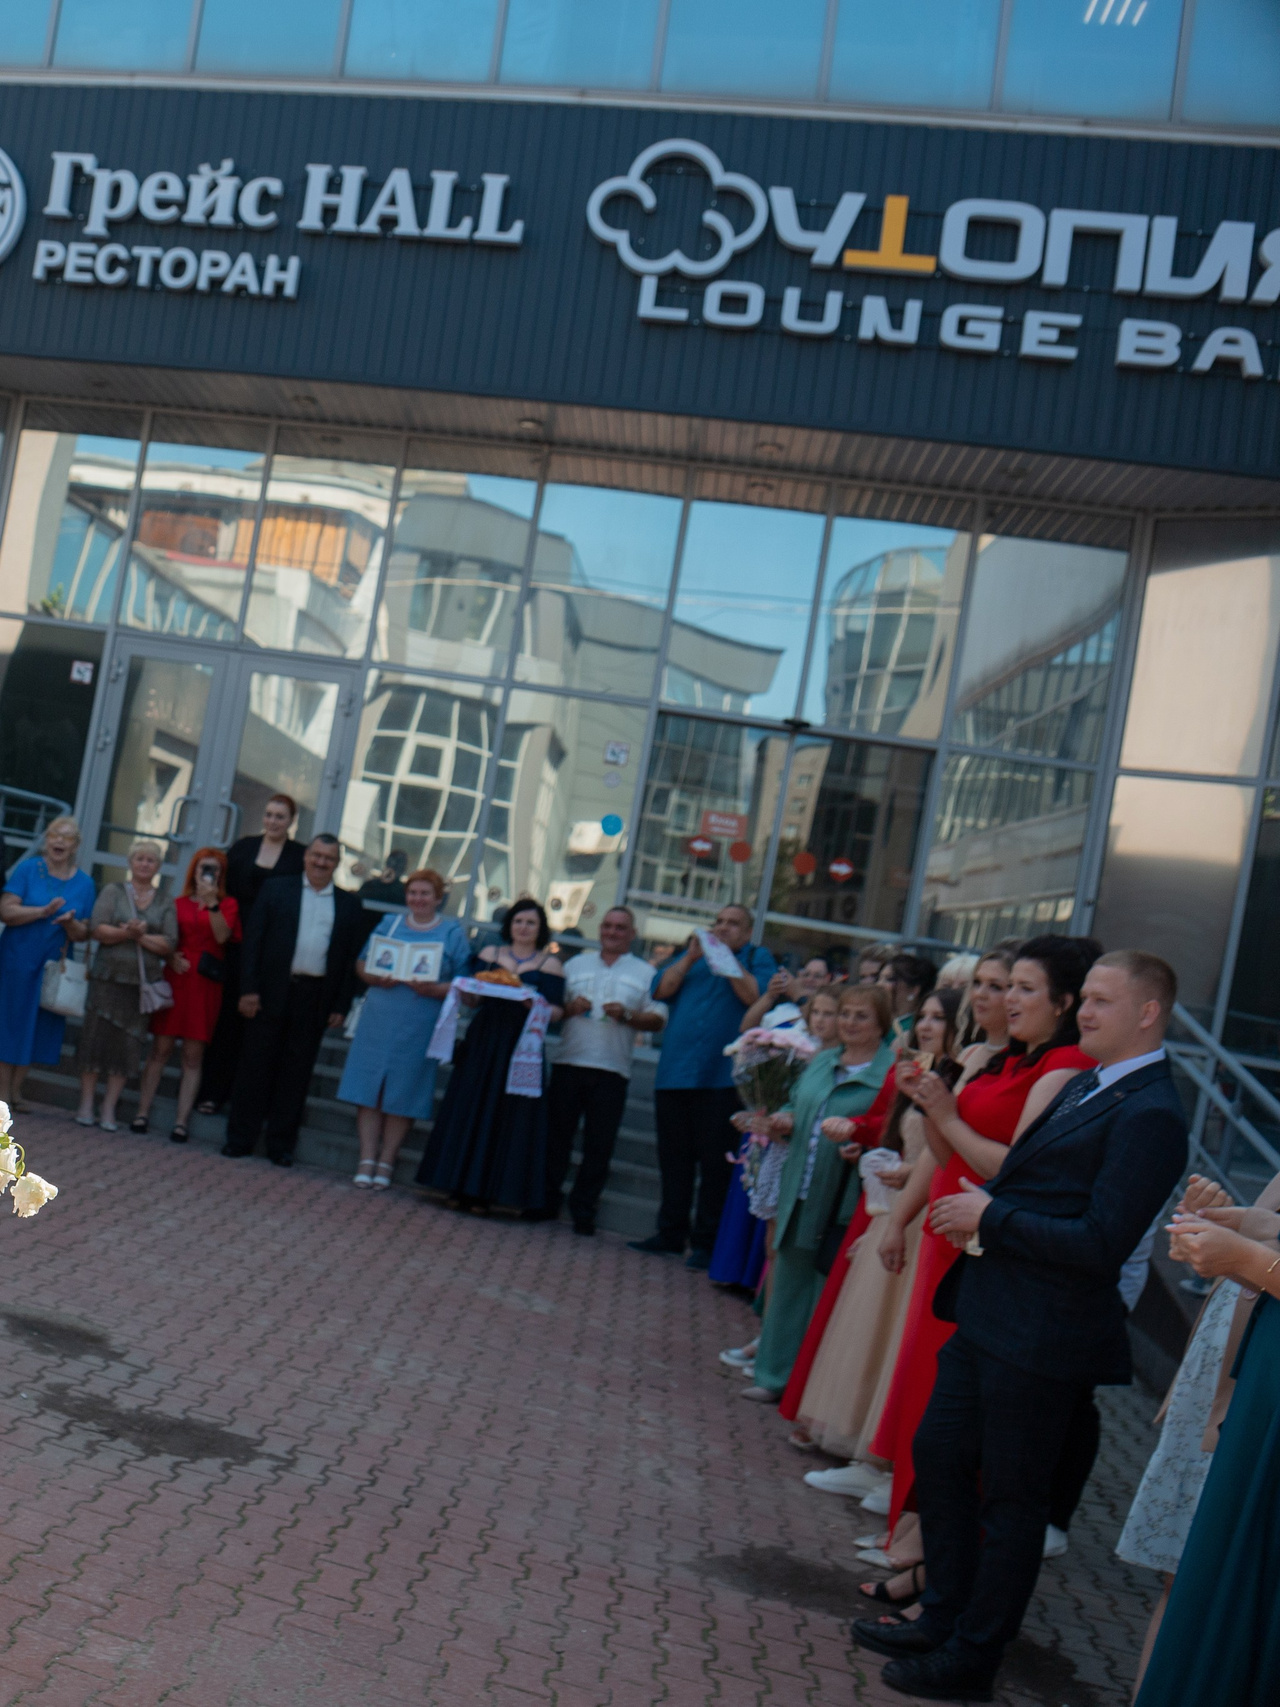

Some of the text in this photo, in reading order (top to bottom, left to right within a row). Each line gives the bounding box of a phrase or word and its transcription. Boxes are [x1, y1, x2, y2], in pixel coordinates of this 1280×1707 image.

[43, 151, 524, 247] Грейс HALL
[769, 186, 1280, 305] УТОПИ
[32, 240, 300, 299] РЕСТОРАН
[637, 275, 1280, 380] LOUNGE BA
